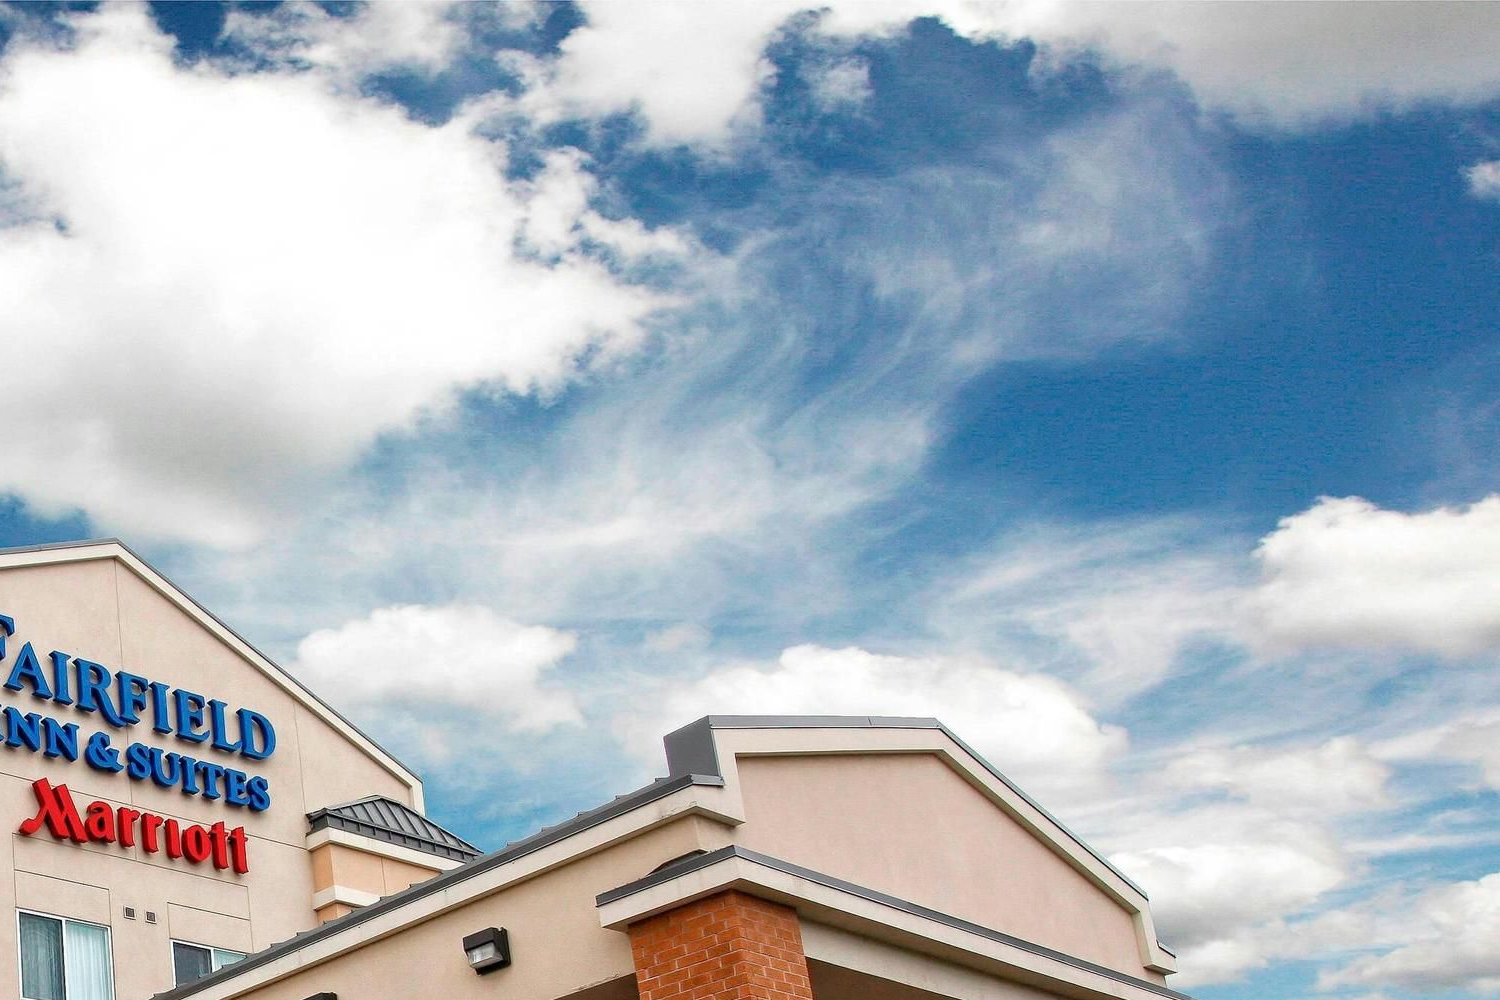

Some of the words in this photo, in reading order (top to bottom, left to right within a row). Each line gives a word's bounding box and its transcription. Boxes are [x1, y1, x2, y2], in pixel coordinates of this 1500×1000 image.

[84, 731, 124, 773] &
[126, 742, 272, 812] SUITES
[18, 777, 250, 875] Marriott
